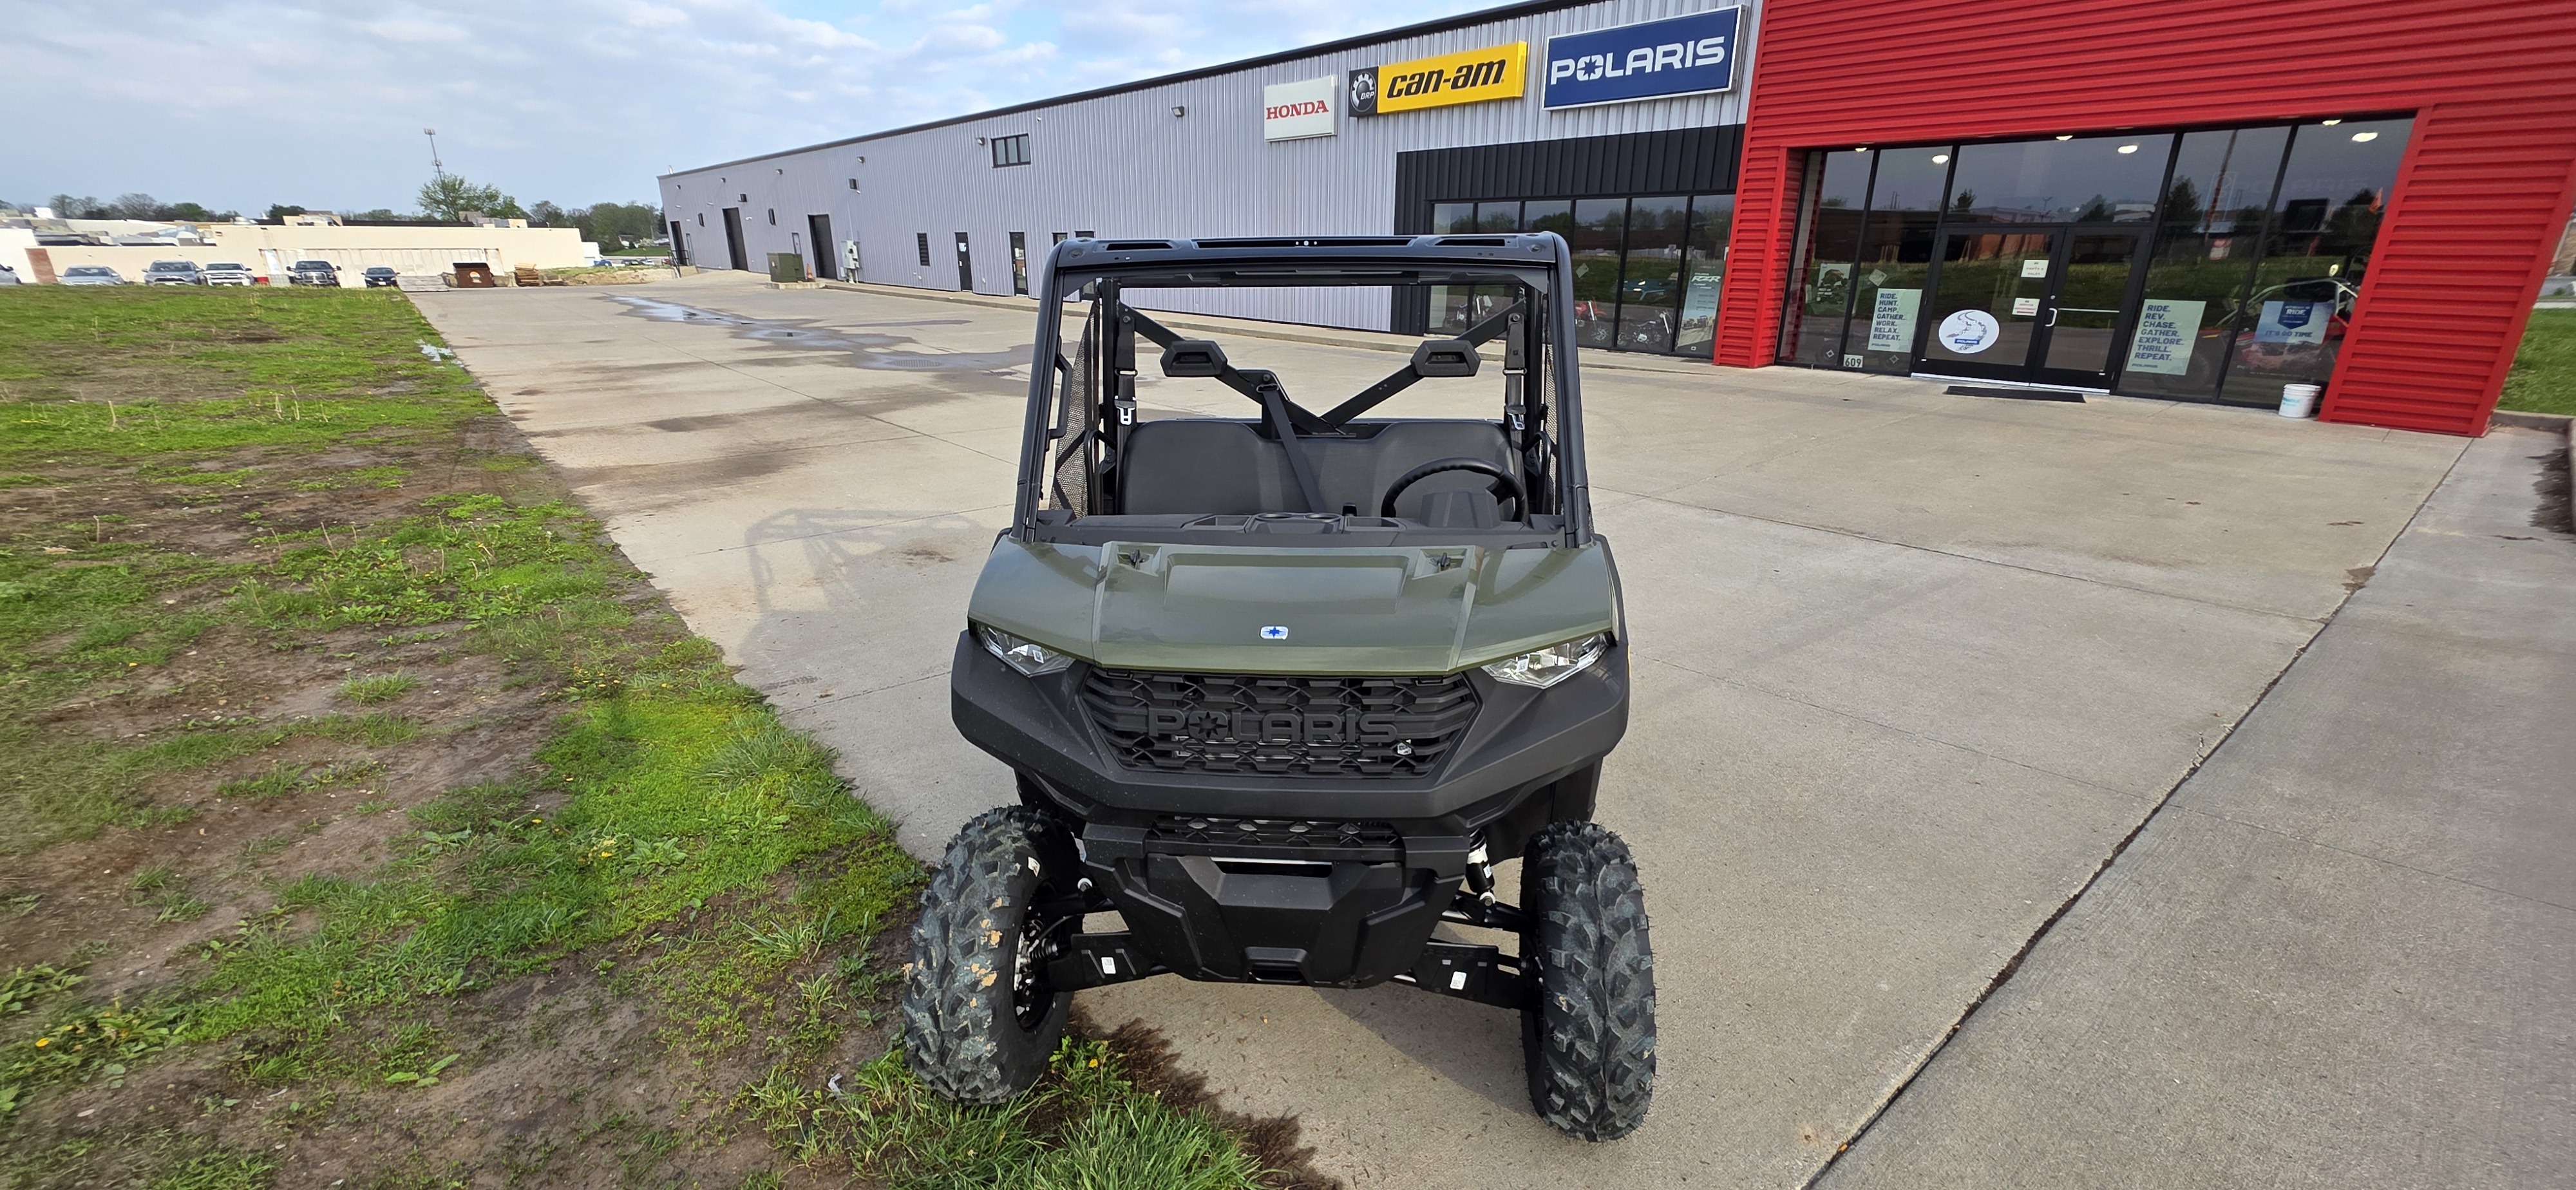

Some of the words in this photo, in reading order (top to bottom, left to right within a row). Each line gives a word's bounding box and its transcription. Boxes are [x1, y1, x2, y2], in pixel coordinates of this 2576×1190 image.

[1550, 36, 1725, 85] POLARIS
[1387, 59, 1506, 99] can-am
[1360, 91, 1375, 100] BRP
[1266, 100, 1329, 120] HONDA
[2138, 337, 2184, 345] EXPLORE.
[2137, 345, 2172, 353] THRILL.
[2134, 352, 2172, 361] REPEAT.
[1845, 357, 1862, 367] 609
[1148, 709, 1398, 743] POLARIS
